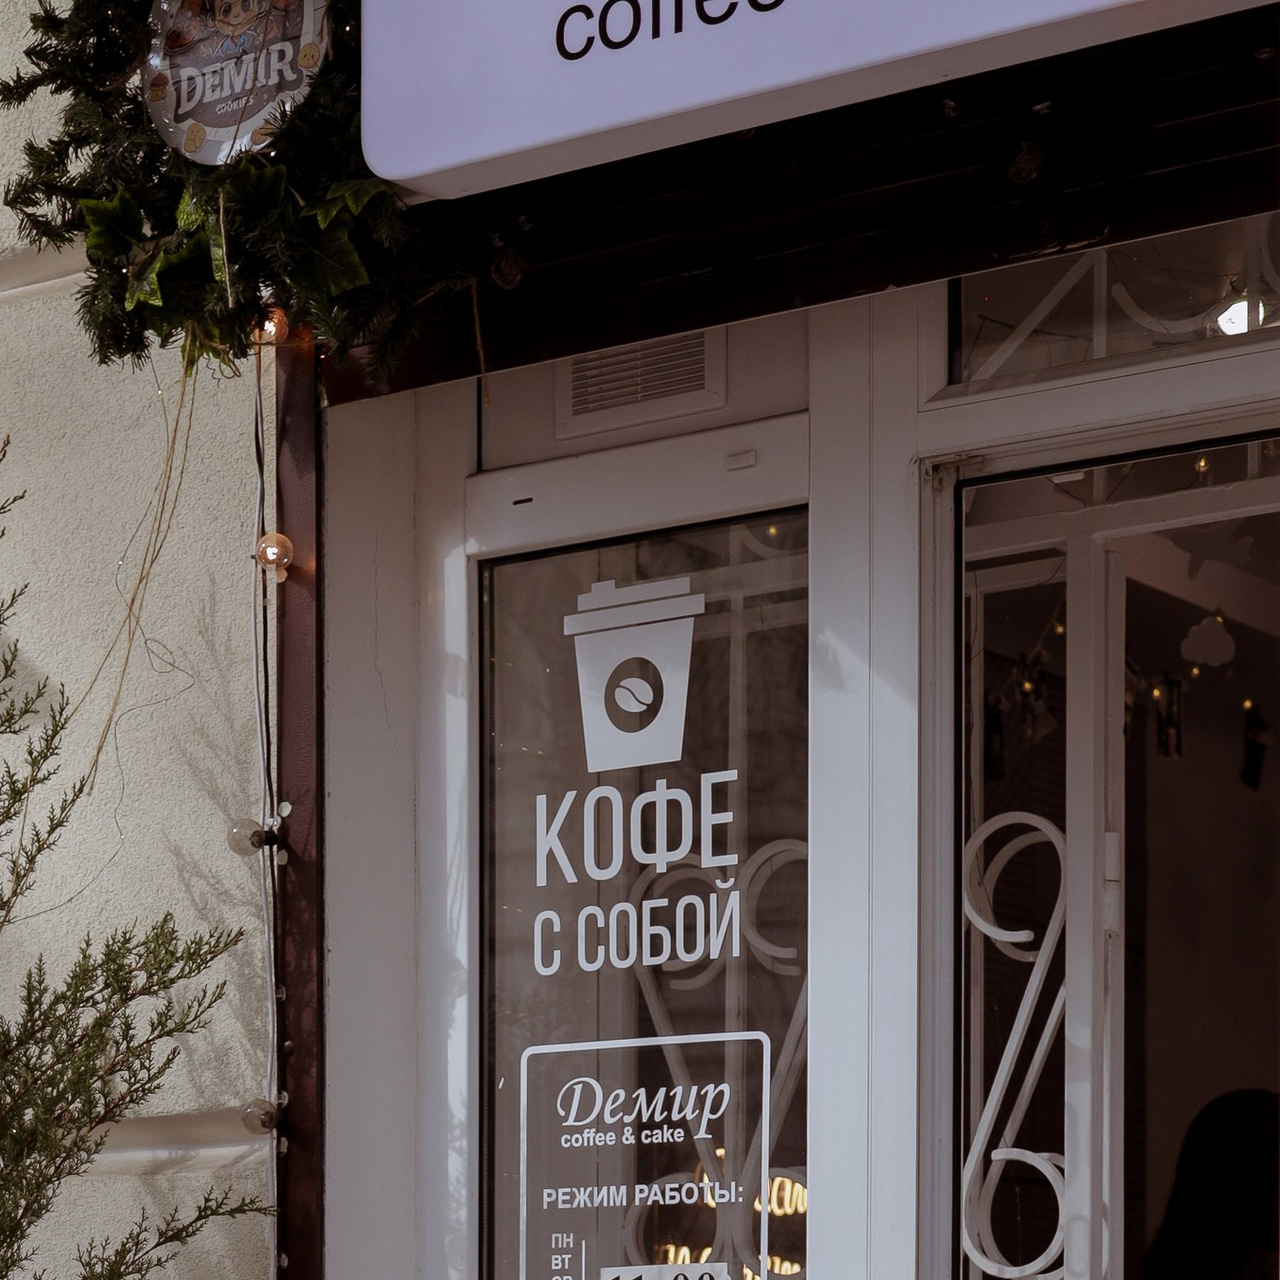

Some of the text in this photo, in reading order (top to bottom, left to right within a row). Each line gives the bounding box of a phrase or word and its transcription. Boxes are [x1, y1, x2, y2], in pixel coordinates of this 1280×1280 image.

[178, 41, 297, 114] DEMIR
[536, 769, 739, 887] КОФЕ
[533, 877, 740, 976] С СОБОЙ
[556, 1076, 731, 1139] Демир
[561, 1125, 685, 1148] coffee & cake
[542, 1184, 627, 1209] РЕЖИМ
[634, 1182, 743, 1205] РАБОТЫ:
[551, 1233, 574, 1248] ПН
[551, 1254, 572, 1270] ВТ
